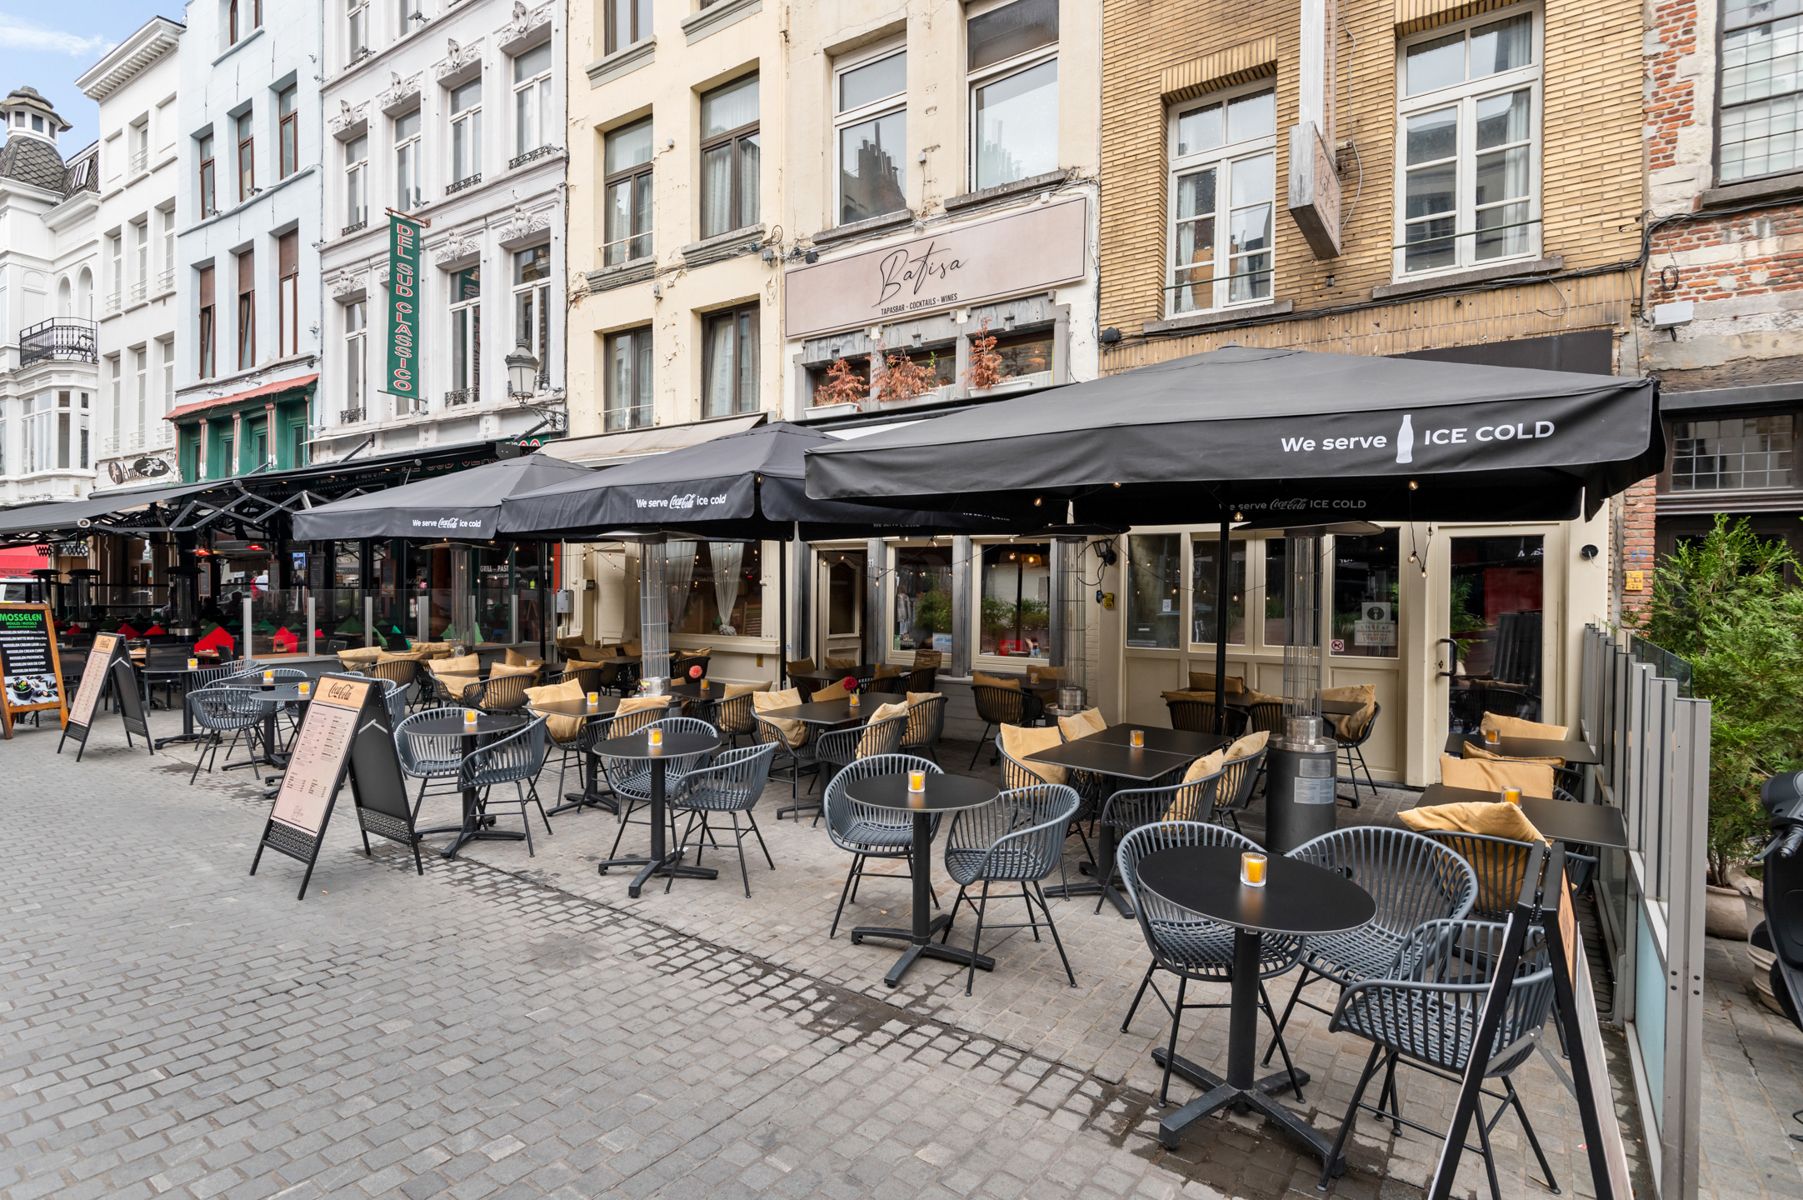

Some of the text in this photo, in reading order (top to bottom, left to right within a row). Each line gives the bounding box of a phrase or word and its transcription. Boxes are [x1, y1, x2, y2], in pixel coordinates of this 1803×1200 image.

[872, 241, 969, 308] Batisa
[393, 223, 414, 391] DEL SUD CLASSICO
[881, 293, 958, 315] TAPASBAR COCKTAILS WINES
[1281, 420, 1555, 452] We serve ICE COLD
[636, 498, 647, 508] We
[648, 499, 668, 508] serve
[696, 495, 708, 506] ice
[710, 493, 727, 505] cold
[1238, 502, 1267, 511] serve
[1310, 499, 1329, 509] ICE
[1332, 499, 1367, 509] COLD
[412, 519, 422, 527] We
[459, 519, 468, 527] ice
[468, 519, 482, 528] cold
[0, 613, 42, 621] MOSSELEN
